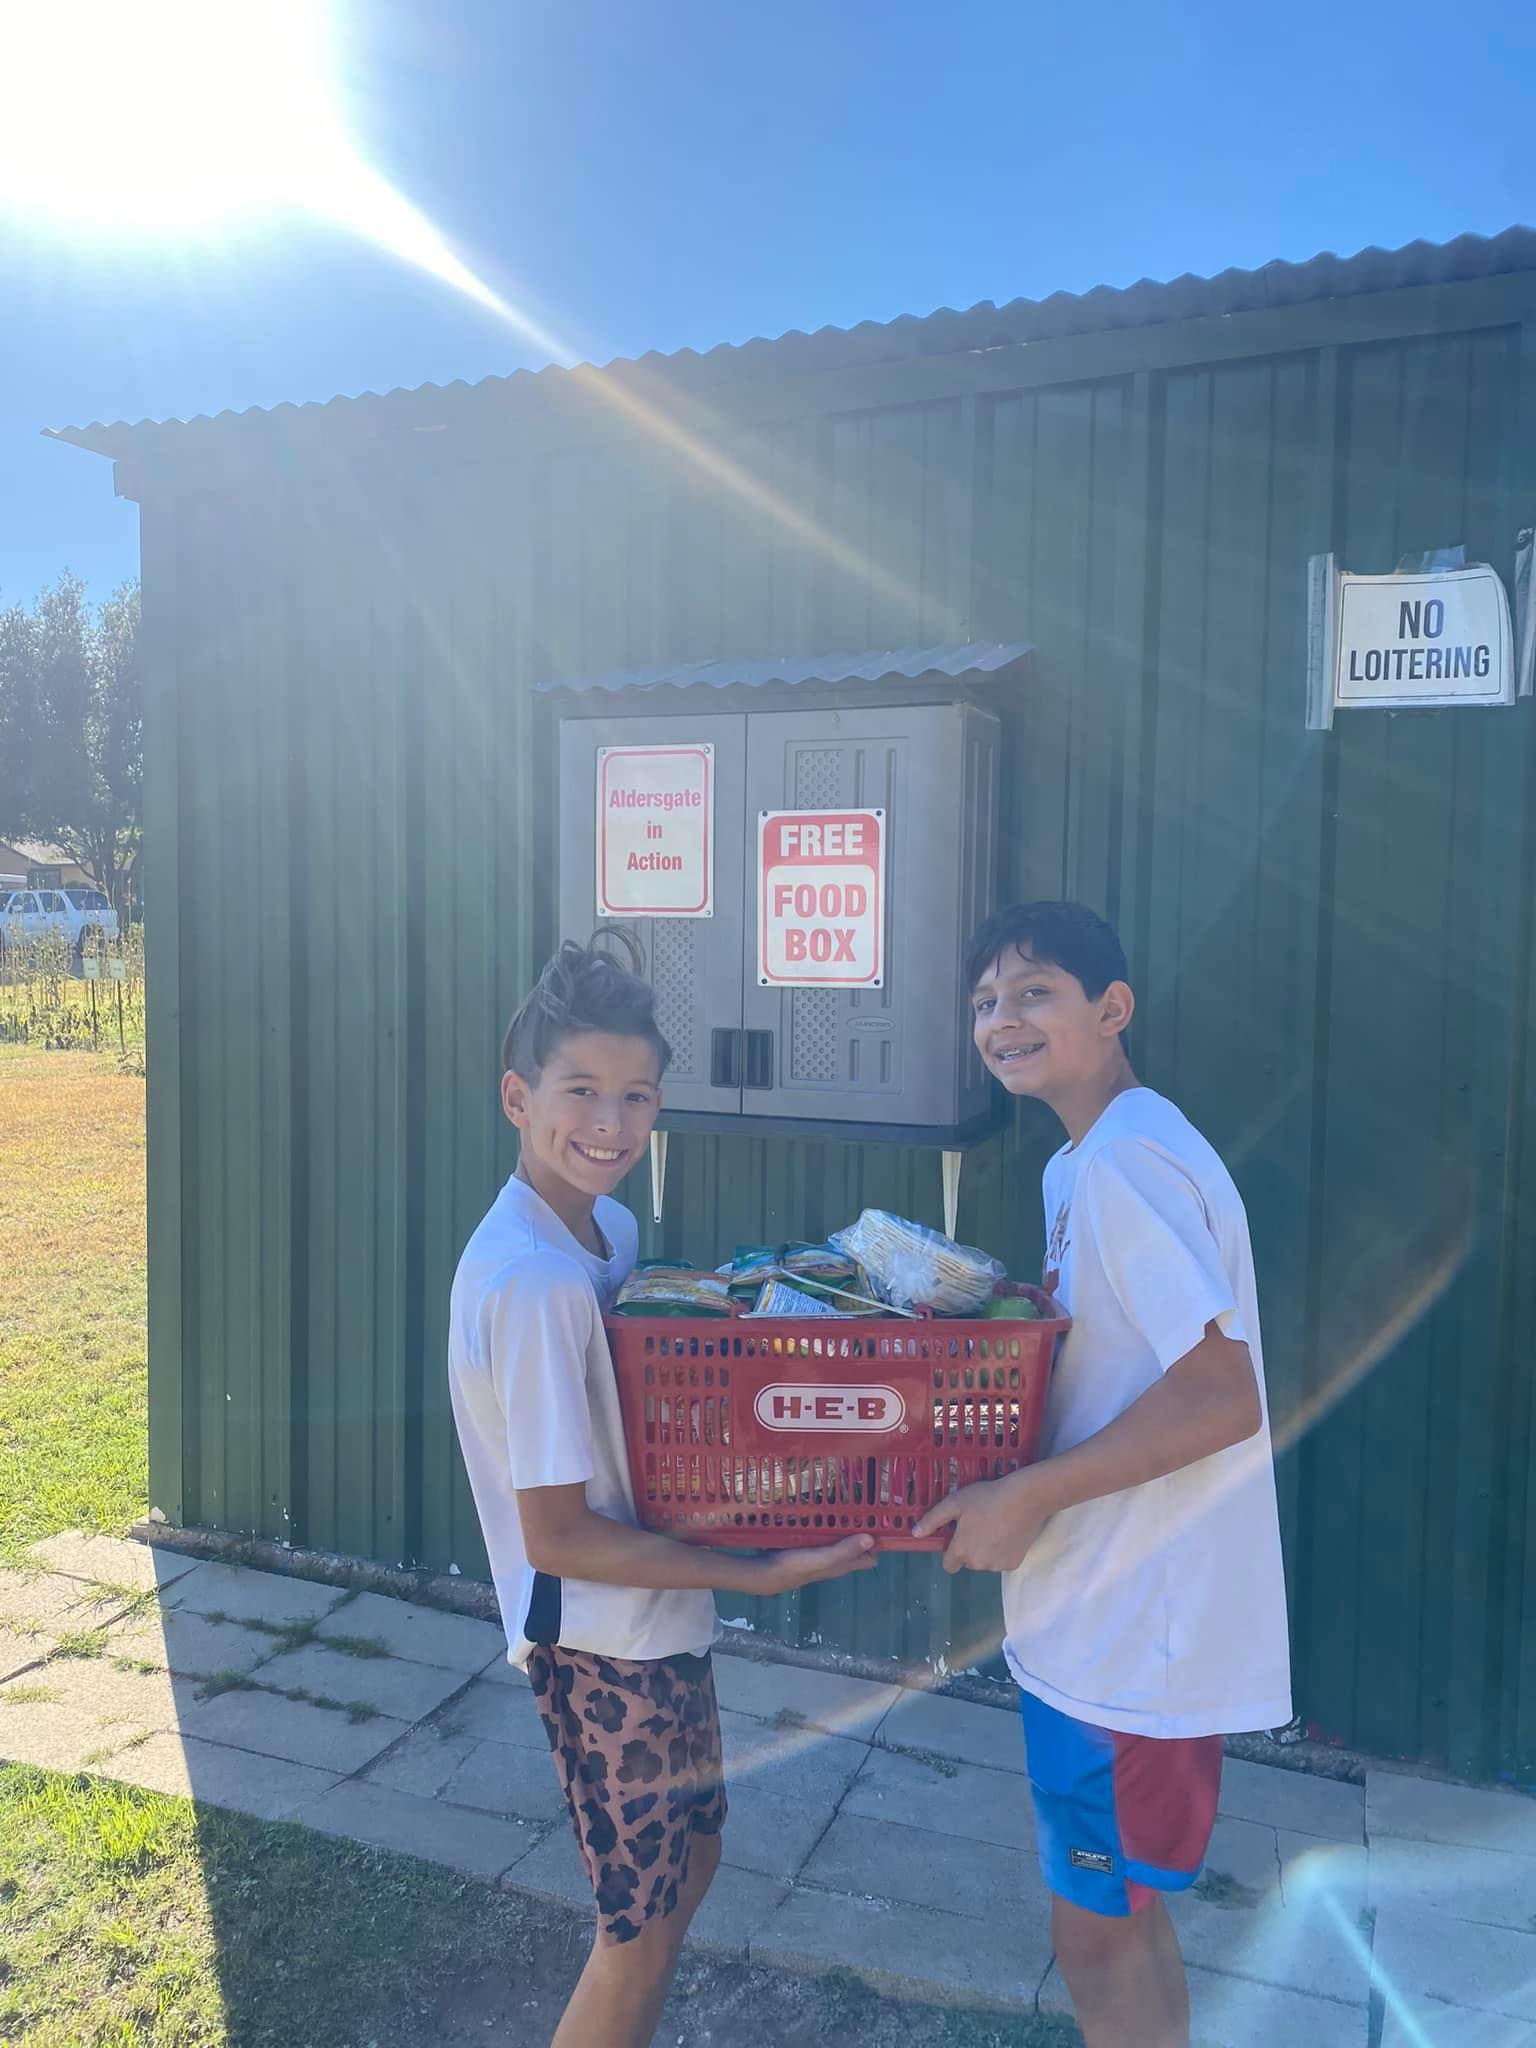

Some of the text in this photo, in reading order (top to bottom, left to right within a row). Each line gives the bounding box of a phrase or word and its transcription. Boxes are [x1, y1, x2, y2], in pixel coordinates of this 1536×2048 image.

[1399, 600, 1444, 639] NO
[1350, 645, 1490, 681] LOITERING
[609, 789, 702, 811] Aldersgate
[646, 821, 663, 839] in
[780, 824, 864, 857] FREE
[627, 852, 682, 870] Action
[774, 884, 867, 918] FOOD
[785, 928, 856, 962] BOX
[773, 1396, 886, 1420] H-E-B
